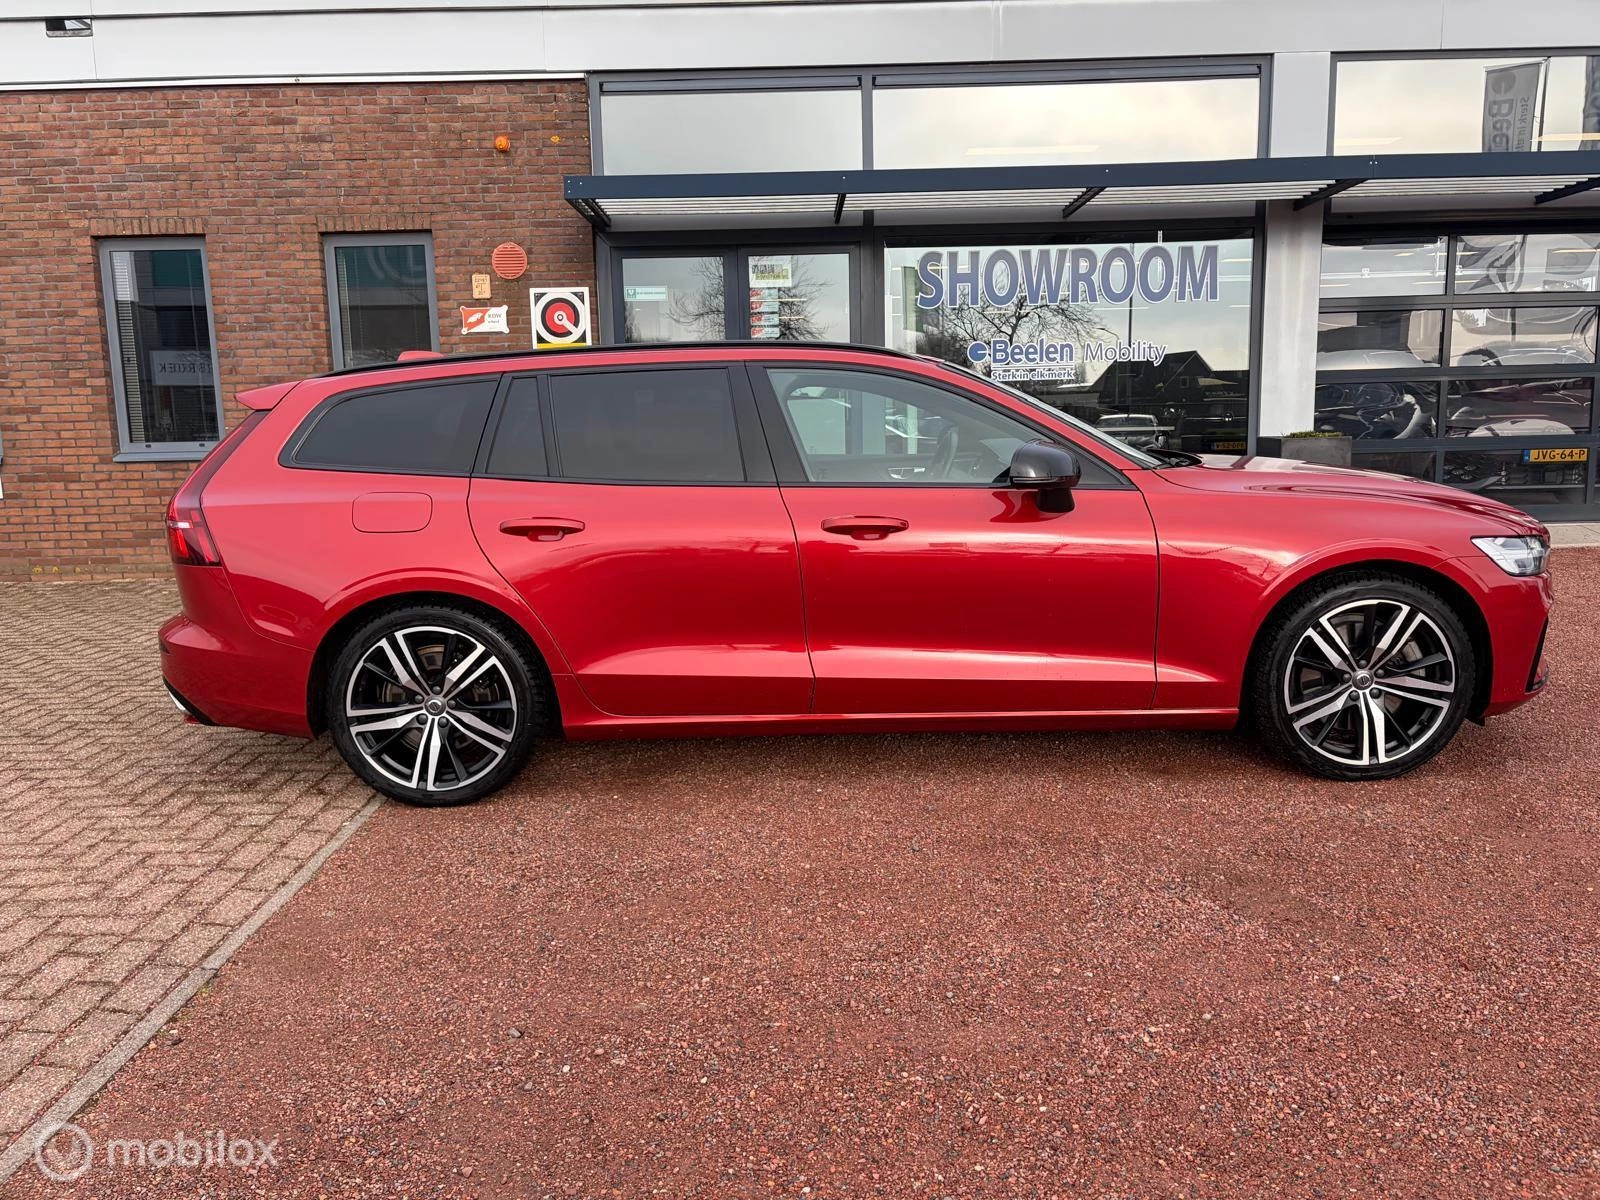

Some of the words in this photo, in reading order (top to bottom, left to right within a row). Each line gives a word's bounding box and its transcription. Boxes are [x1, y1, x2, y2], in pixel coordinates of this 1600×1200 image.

[917, 245, 1219, 308] SHOWROOM
[991, 339, 1074, 364] Beelen
[1085, 341, 1166, 365] Mobility
[992, 371, 1018, 380] Sterk
[1019, 371, 1029, 379] in
[1031, 370, 1046, 379] elk
[1047, 369, 1073, 379] merk
[1533, 449, 1586, 460] JVG-64-P
